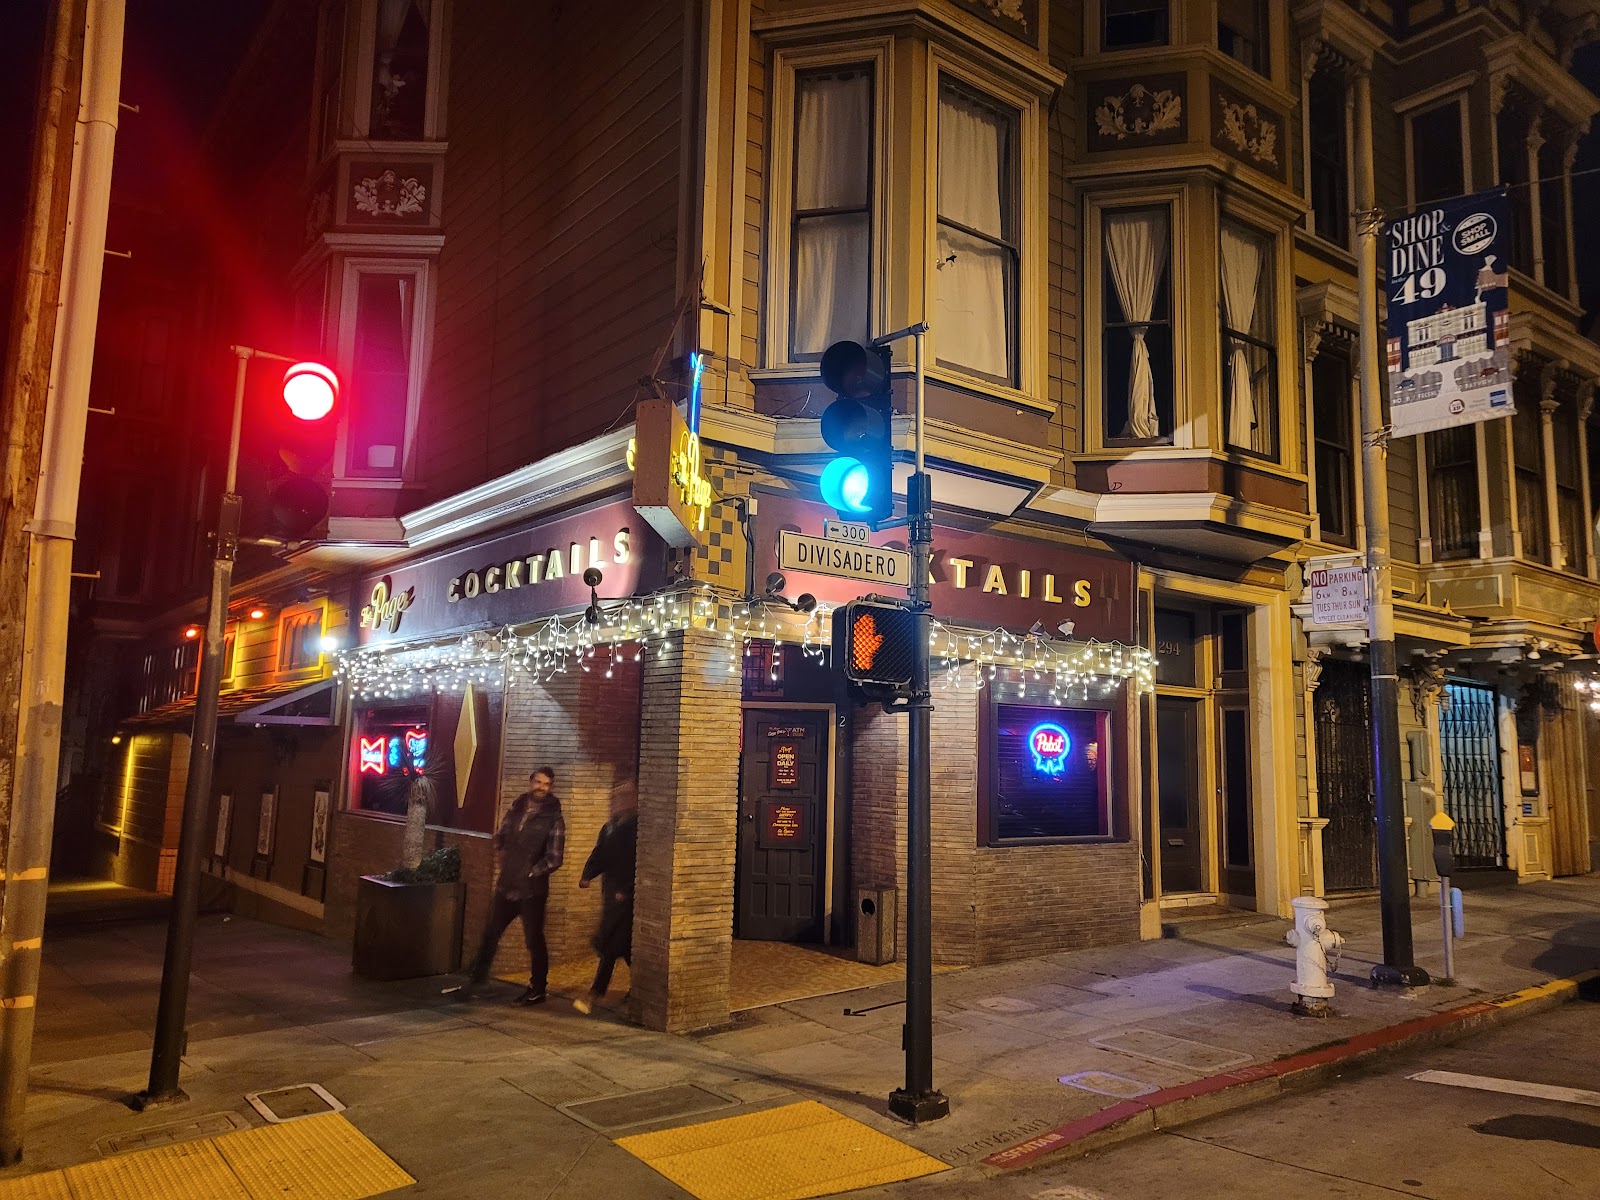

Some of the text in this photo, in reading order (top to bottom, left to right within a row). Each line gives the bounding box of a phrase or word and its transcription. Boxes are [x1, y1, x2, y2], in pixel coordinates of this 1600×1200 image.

[1391, 209, 1451, 249] SHOP &
[1460, 229, 1491, 246] SMALL
[1461, 222, 1487, 238] SHOP
[1391, 236, 1444, 278] DINE
[1391, 267, 1446, 306] 49
[842, 526, 866, 541] 300
[447, 531, 629, 603] COCKTAILS
[798, 542, 896, 577] DIVISADERO
[1313, 571, 1362, 586] NO PARKING
[360, 581, 410, 633] The Page
[1317, 600, 1361, 612] TUES THUR SUN
[1158, 640, 1180, 656] 294
[1035, 733, 1065, 752] Pabst
